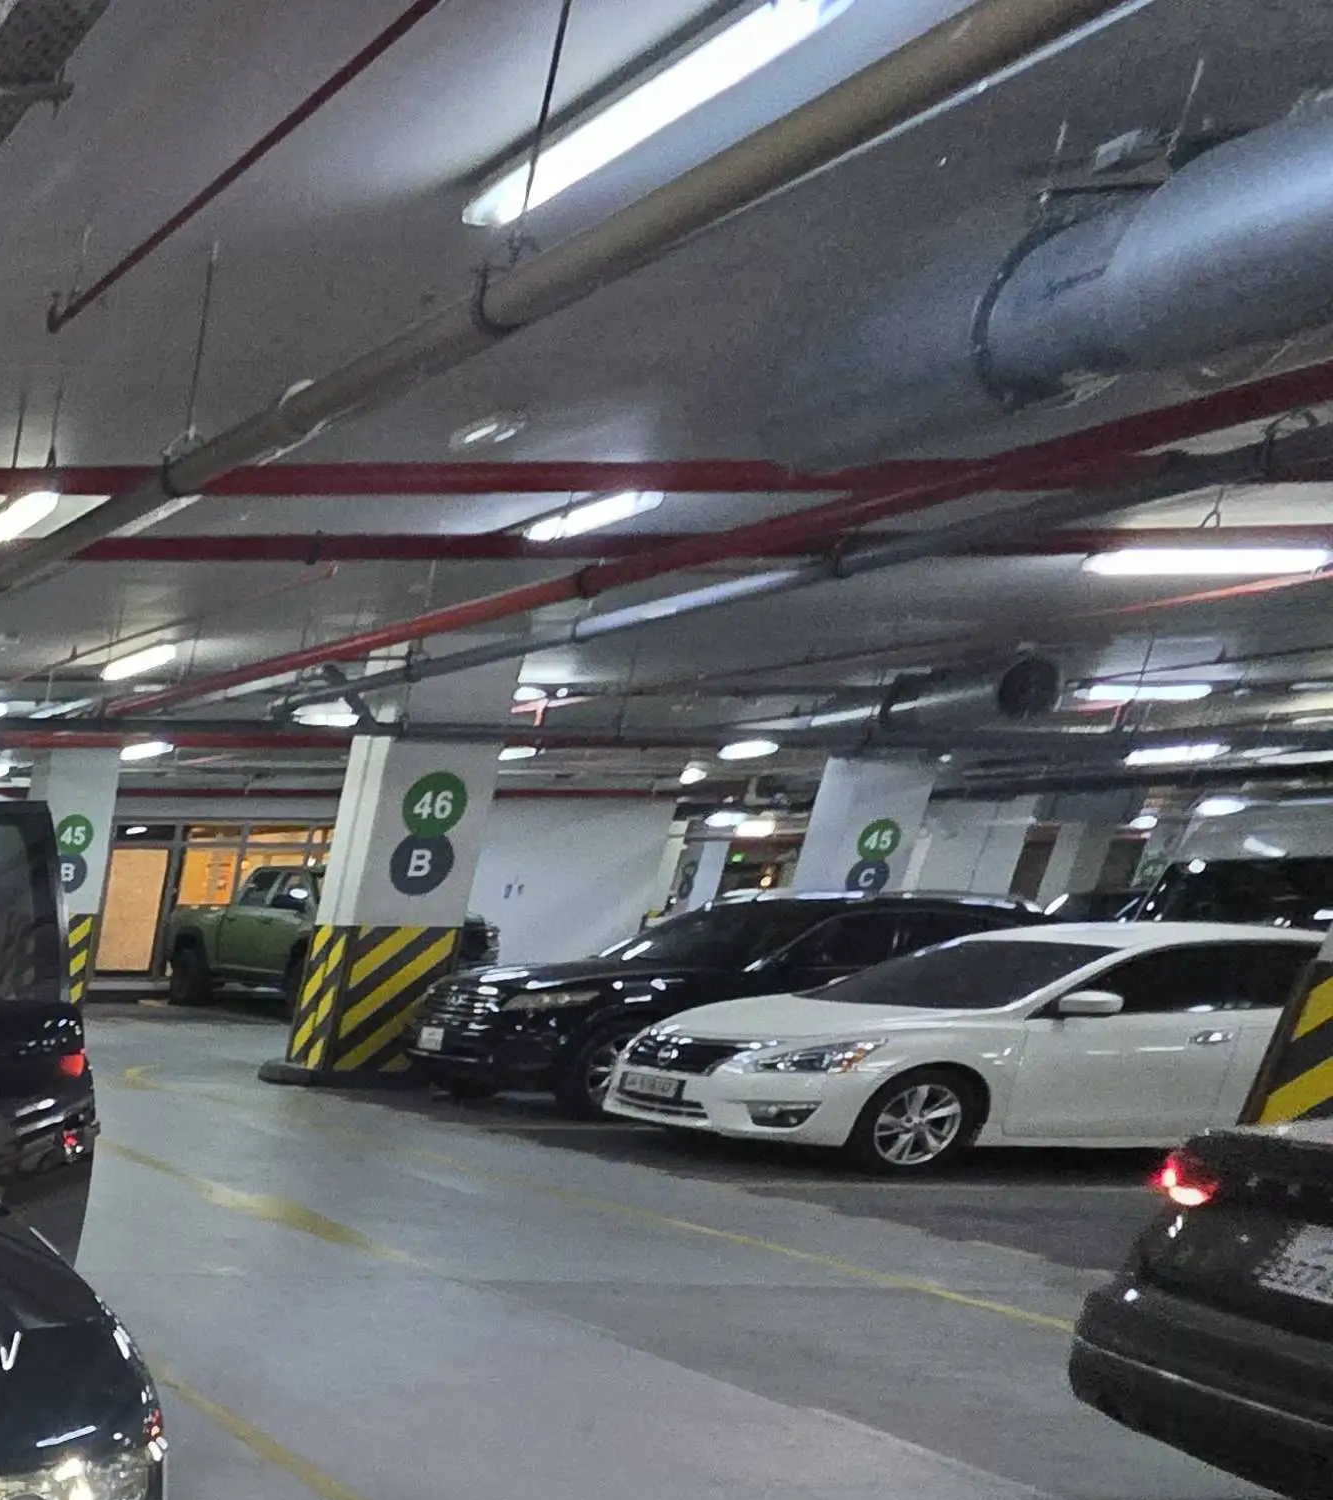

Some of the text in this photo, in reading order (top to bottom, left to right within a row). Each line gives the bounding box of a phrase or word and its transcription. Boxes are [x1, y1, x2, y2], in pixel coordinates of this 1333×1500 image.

[413, 790, 453, 819] 46
[59, 826, 86, 846] 45
[60, 863, 76, 882] B
[407, 848, 433, 877] B
[858, 868, 876, 887] C
